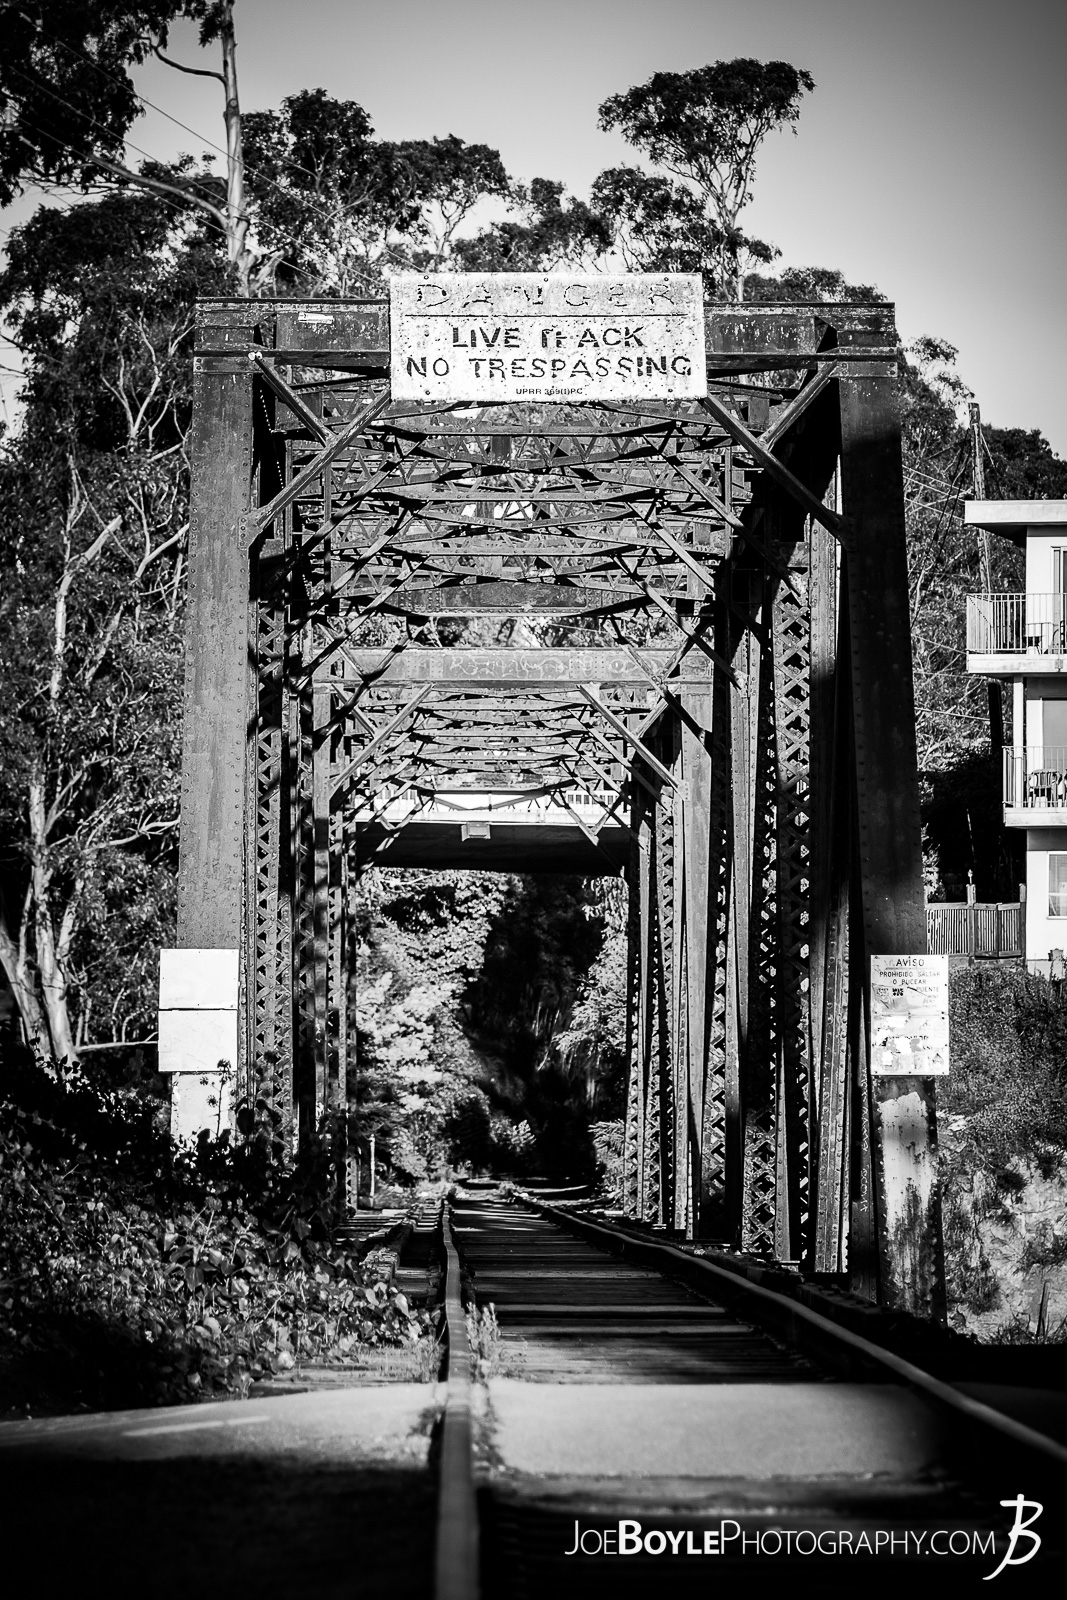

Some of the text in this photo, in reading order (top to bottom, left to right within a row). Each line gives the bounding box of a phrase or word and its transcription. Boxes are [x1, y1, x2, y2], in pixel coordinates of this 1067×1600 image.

[416, 283, 675, 308] DANGER
[452, 327, 519, 347] LIVE
[406, 356, 691, 379] NO TRESPASSING
[896, 958, 925, 967] AVISO
